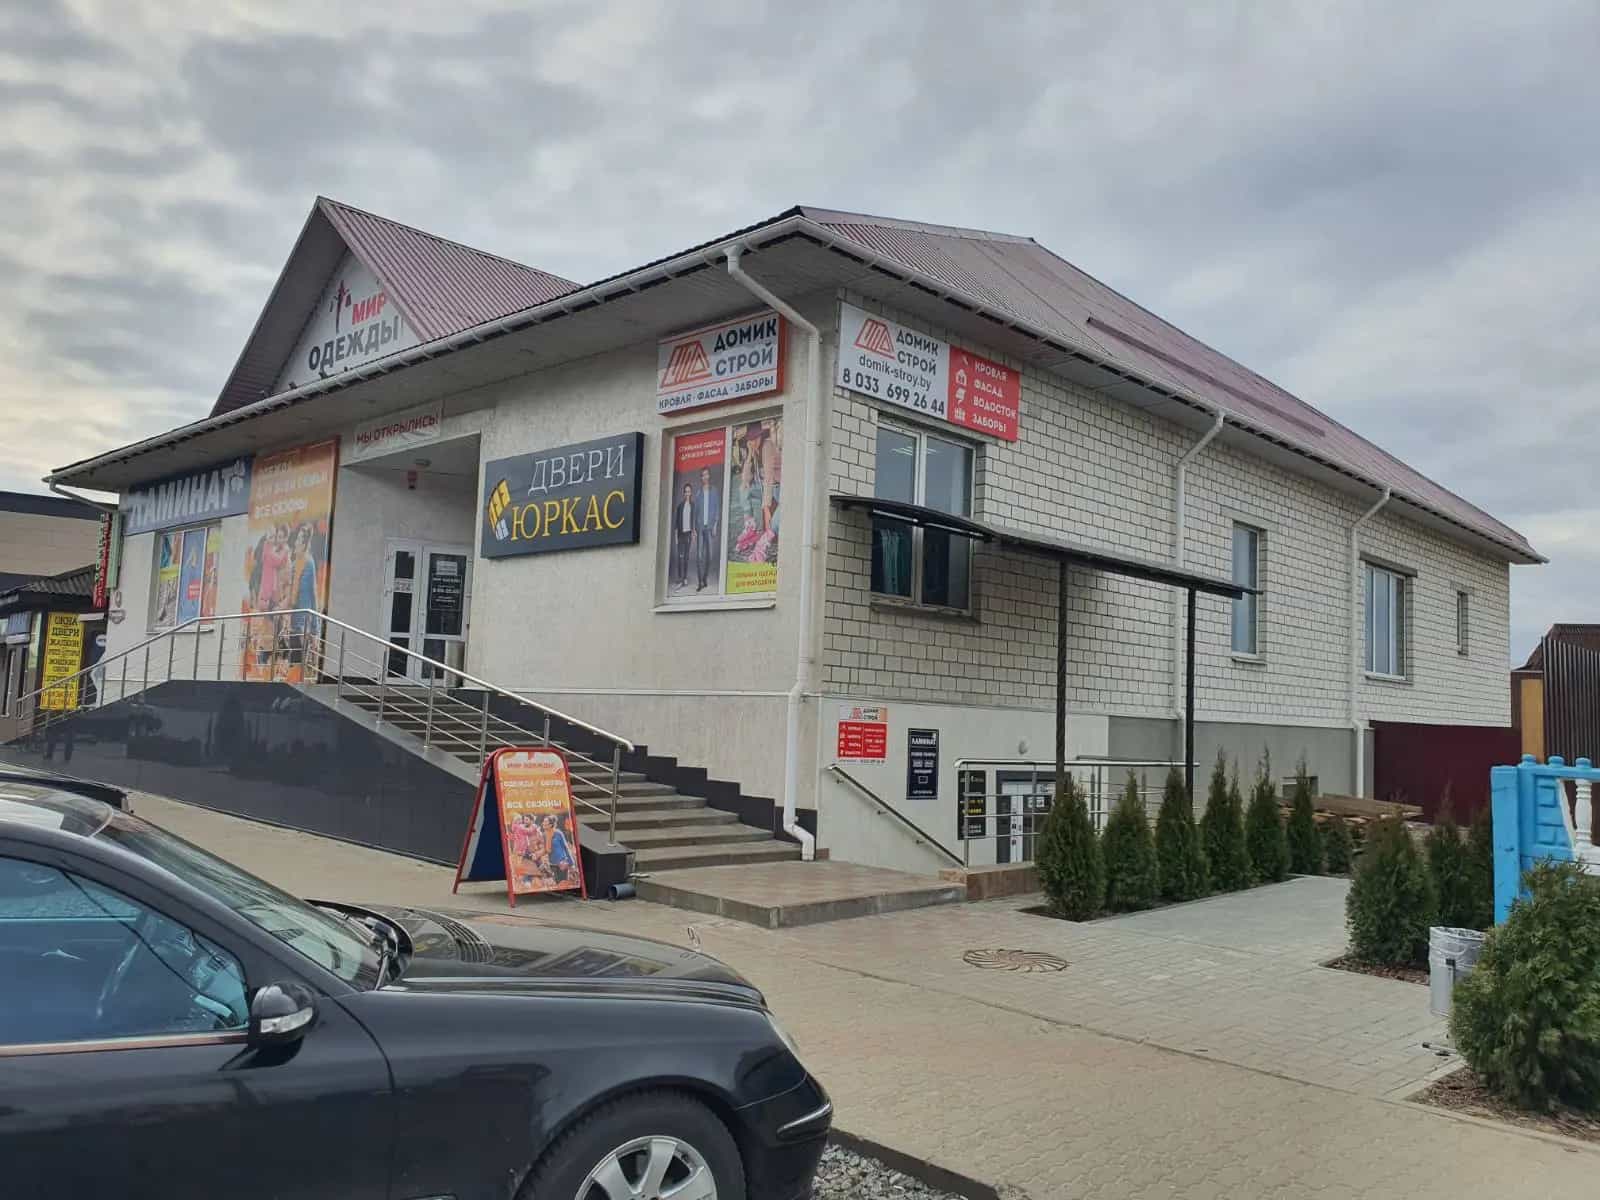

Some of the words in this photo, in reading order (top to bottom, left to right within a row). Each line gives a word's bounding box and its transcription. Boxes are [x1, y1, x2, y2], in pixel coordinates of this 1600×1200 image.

[352, 292, 386, 325] МИР
[308, 316, 399, 372] ОДЕЖДЫ
[714, 319, 777, 352] ДОМИК
[896, 328, 939, 357] ДОМИК
[716, 342, 774, 376] СТРОЙ
[859, 354, 932, 391] domik-stroy.by
[897, 350, 937, 376] СТРОЙ
[974, 361, 1008, 382] КРОВЛЯ
[660, 395, 692, 409] КРОВЛЯ
[697, 387, 728, 400] ФАСАД
[735, 376, 774, 393] ЗАБОРЫ
[842, 368, 851, 384] 8
[855, 372, 880, 393] 033
[887, 384, 910, 404] 699
[913, 391, 928, 409] 26
[930, 399, 945, 415] 44
[973, 379, 1003, 398] ФАСАД
[972, 412, 1007, 433] ЗАБОРЫ
[973, 395, 1017, 419] ВОДОСТОК
[527, 444, 627, 496] ДВЕРИ
[129, 466, 233, 528] ЛАМИНАТ
[510, 490, 625, 541] ЮРКАС
[52, 627, 80, 637] ДВЕРИ
